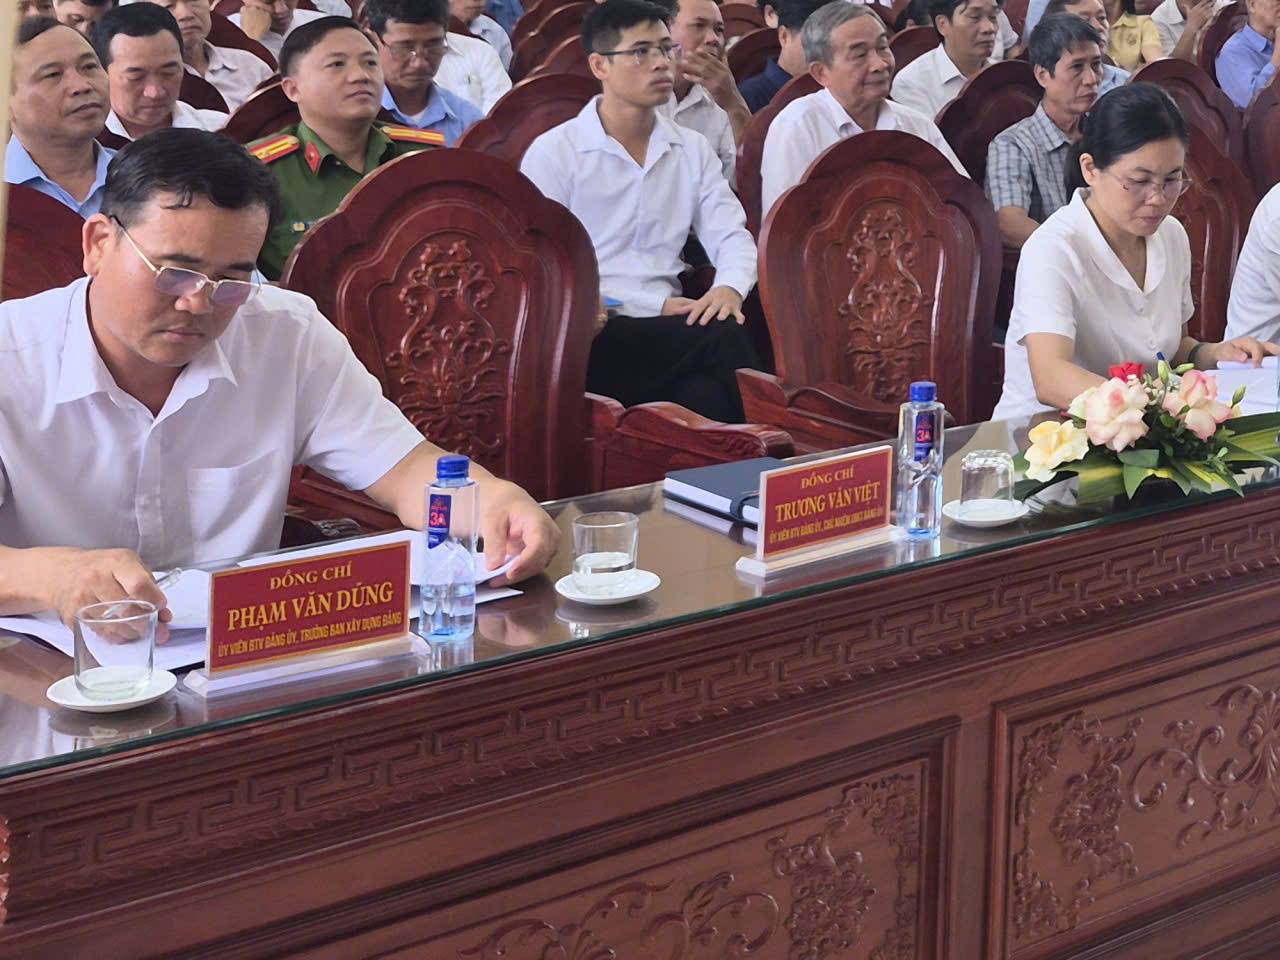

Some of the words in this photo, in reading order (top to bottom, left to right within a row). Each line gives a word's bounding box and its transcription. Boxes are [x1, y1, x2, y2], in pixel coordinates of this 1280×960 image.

[801, 470, 833, 489] ĐỒNG
[834, 463, 855, 481] CHÍ
[775, 493, 826, 522] TRƯƠNG
[828, 487, 853, 510] VĂN
[853, 479, 881, 505] VIỆT
[429, 511, 447, 527] 3A
[270, 569, 318, 590] ĐỒNG
[322, 560, 353, 581] CHÍ
[227, 600, 287, 632] PHẠM
[291, 591, 333, 619] VĂN
[336, 580, 394, 612] DŨNG
[229, 638, 250, 656] VIÊN
[329, 620, 346, 637] BAN
[346, 617, 363, 633] XÂY
